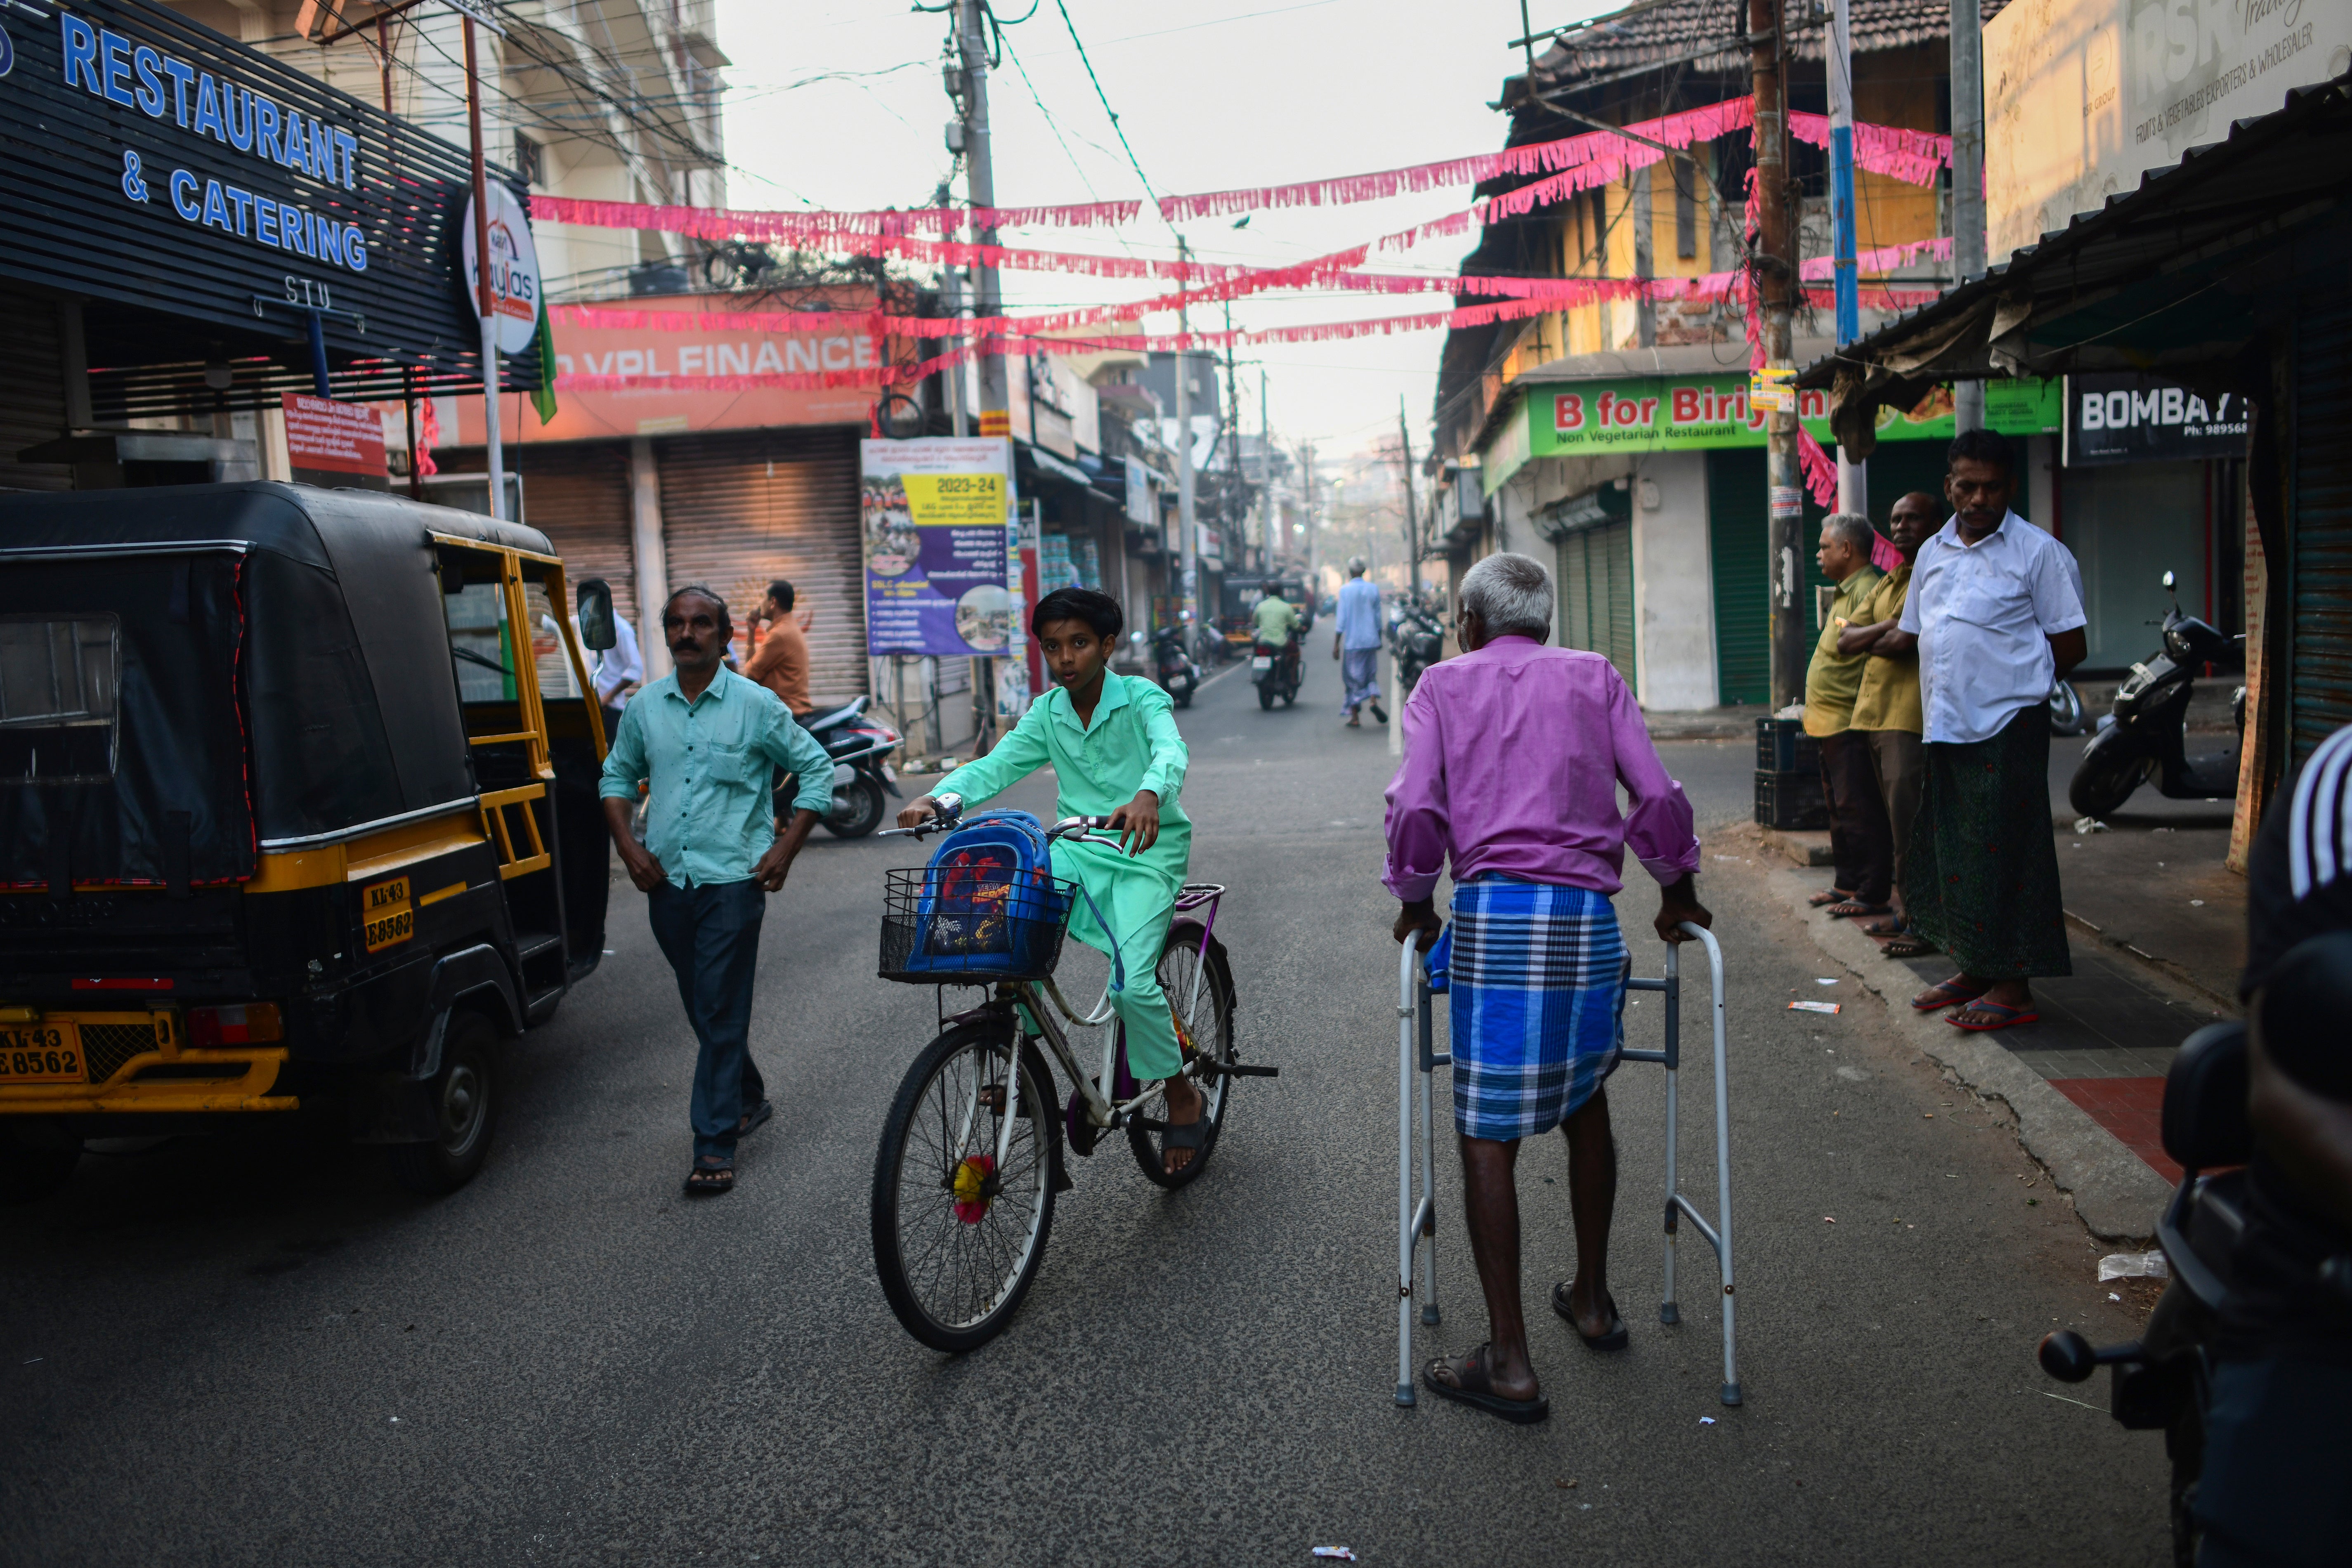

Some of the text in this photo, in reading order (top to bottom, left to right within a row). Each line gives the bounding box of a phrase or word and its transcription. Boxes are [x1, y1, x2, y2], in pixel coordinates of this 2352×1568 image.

[2136, 21, 2313, 145] FRUITS & VEGETABLES EXPORTERS & WHOLESALER
[59, 11, 358, 191] RESTAURANT
[2083, 86, 2115, 118] RSR GROUP
[121, 149, 368, 272] & CATERING
[678, 335, 879, 376] FINANCE
[1554, 393, 1585, 430] B
[1596, 390, 1659, 428] for
[2082, 387, 2231, 430] BOMBAY
[1556, 424, 1736, 444] Non Vegetarian Restaurant
[937, 477, 996, 494] 2023-24
[371, 882, 404, 907] KL-43
[972, 884, 1011, 903] HEROES
[977, 883, 1001, 892] TEAM
[367, 912, 411, 947] E8562
[0, 1029, 62, 1048] KL-43
[0, 1051, 78, 1074] E8562
